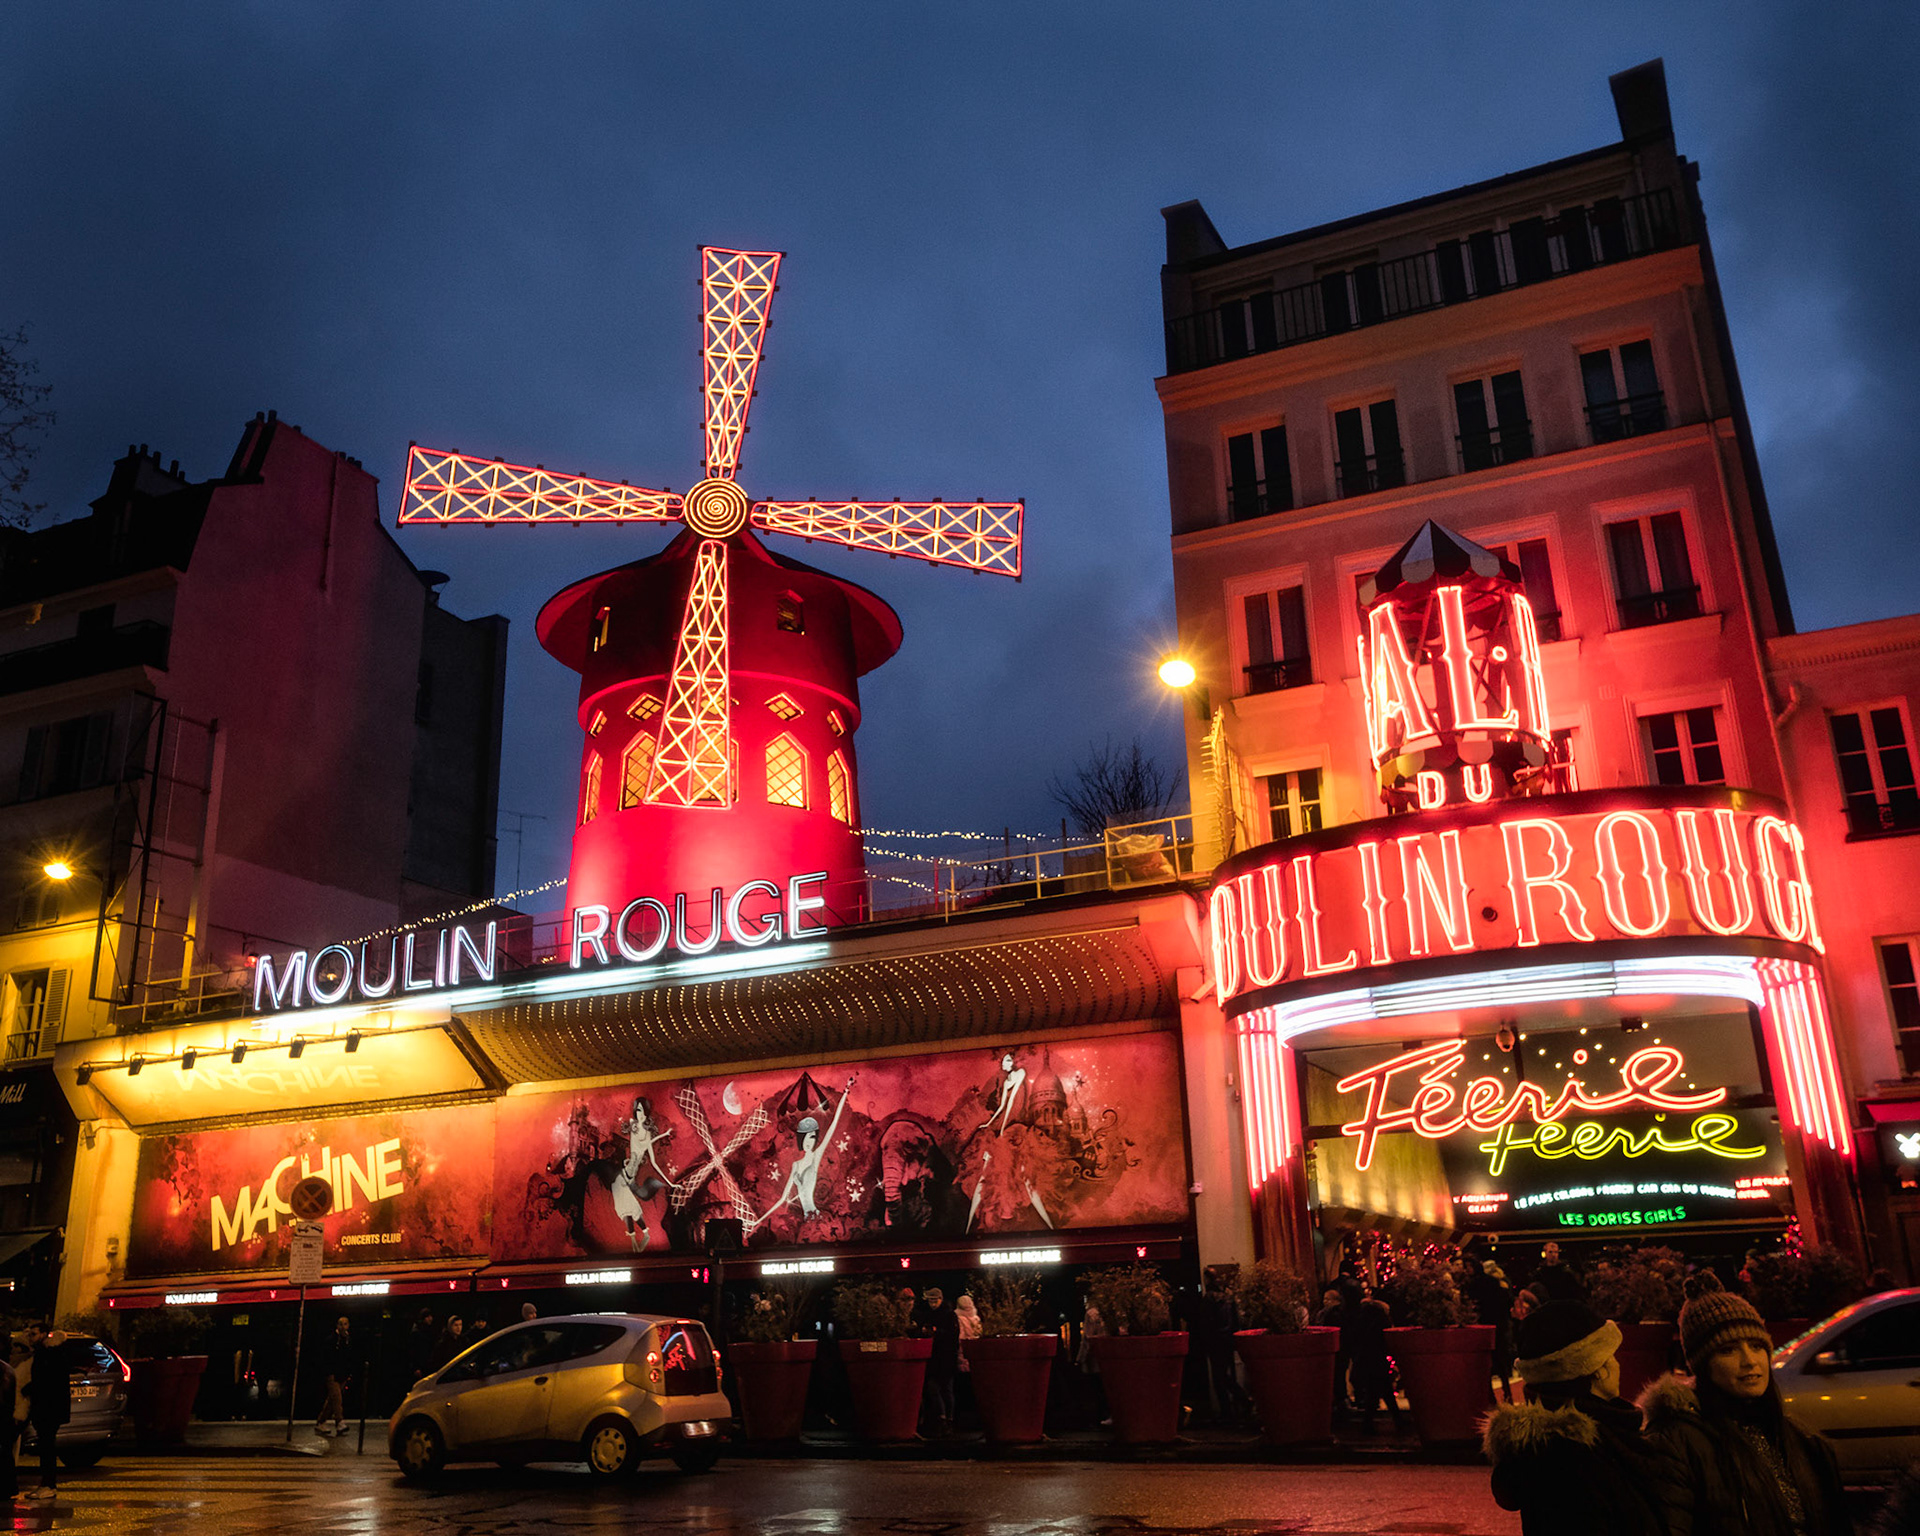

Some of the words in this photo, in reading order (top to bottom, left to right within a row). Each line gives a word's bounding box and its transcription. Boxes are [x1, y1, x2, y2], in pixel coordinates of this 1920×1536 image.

[1417, 763, 1493, 810] DU
[1210, 829, 1474, 1007] OULIN
[1500, 808, 1826, 955] ROUG
[252, 921, 497, 1011] MOULIN
[569, 870, 829, 970] ROUGE
[1336, 1037, 1727, 1171] Féerie
[211, 1138, 404, 1251] MACHINE
[1461, 1193, 1509, 1203] AQUARIUM
[1528, 1193, 1553, 1206] PLUS
[1637, 1183, 1659, 1194] CAN
[1682, 1184, 1699, 1195] DU
[1558, 1213, 1584, 1226] LES
[1588, 1211, 1642, 1227] DORISS
[1644, 1206, 1687, 1224] GIRLS
[341, 1234, 380, 1246] CONCERTS
[381, 1232, 402, 1244] CLUB
